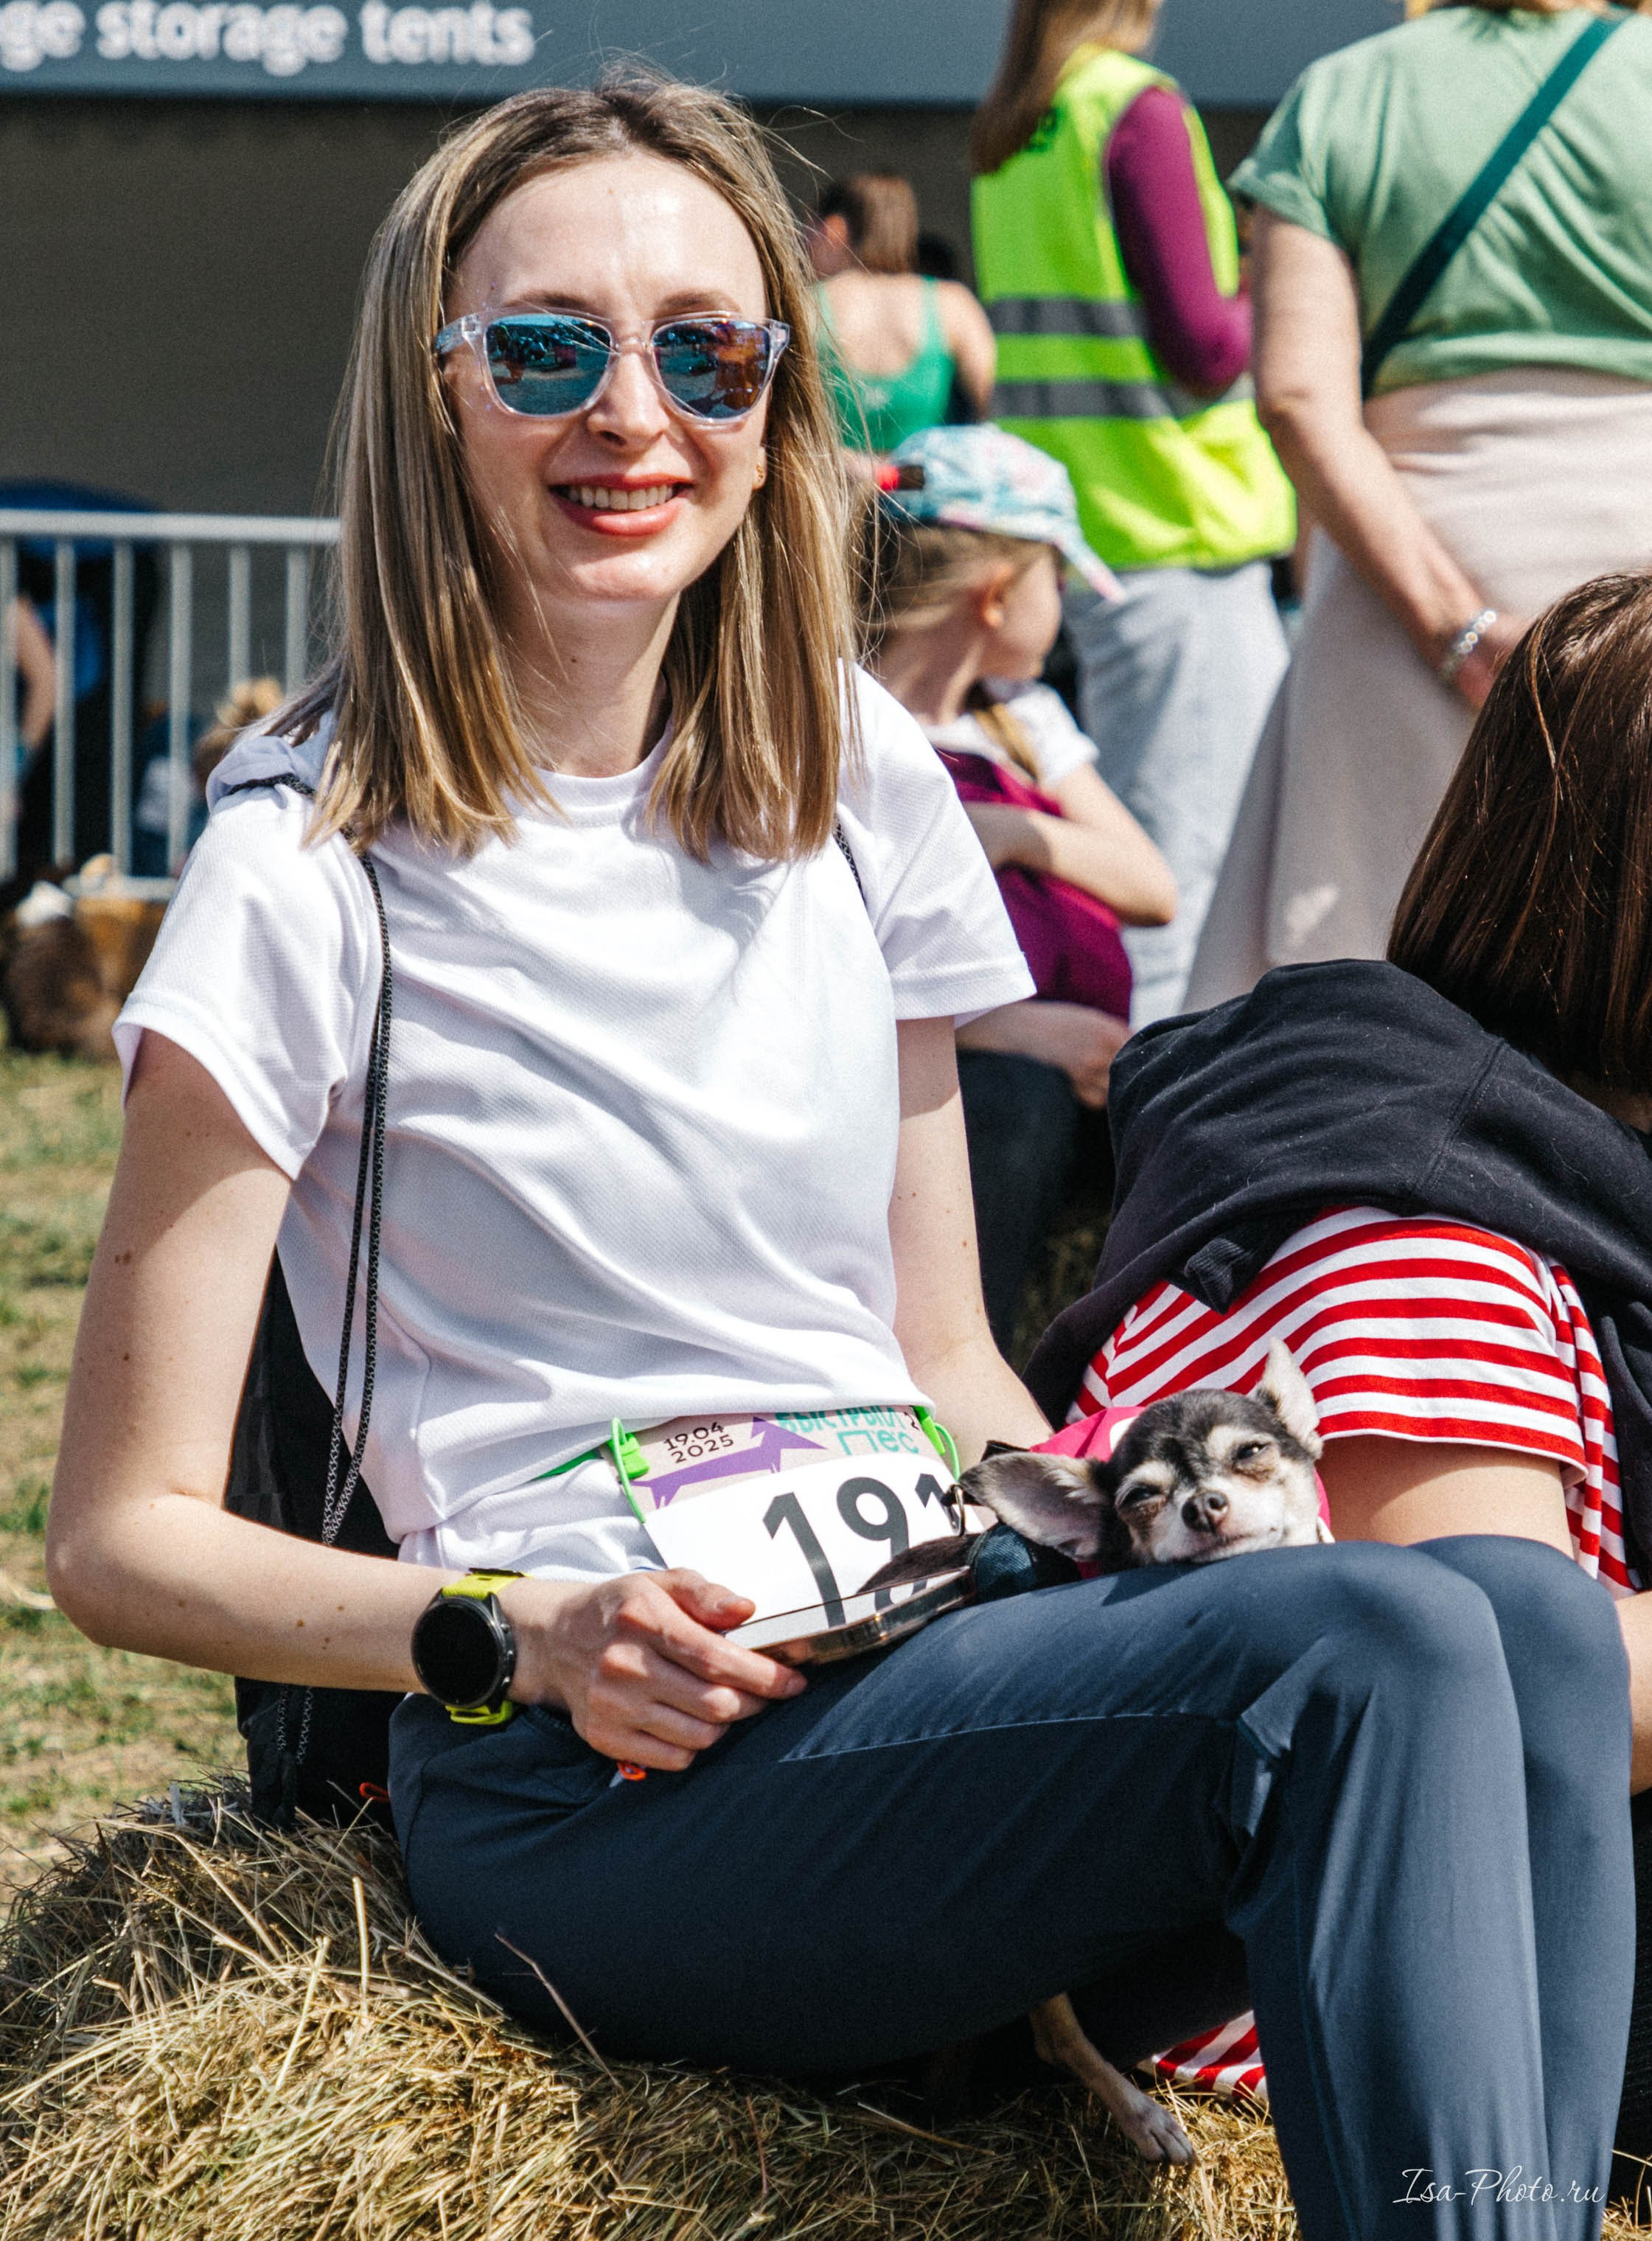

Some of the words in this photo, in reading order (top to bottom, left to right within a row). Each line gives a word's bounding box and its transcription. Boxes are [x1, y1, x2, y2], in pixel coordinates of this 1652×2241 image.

[97, 1, 347, 75] storage
[360, 0, 535, 65] tents
[664, 1421, 723, 1450] 19.04
[671, 1434, 733, 1463] 2025
